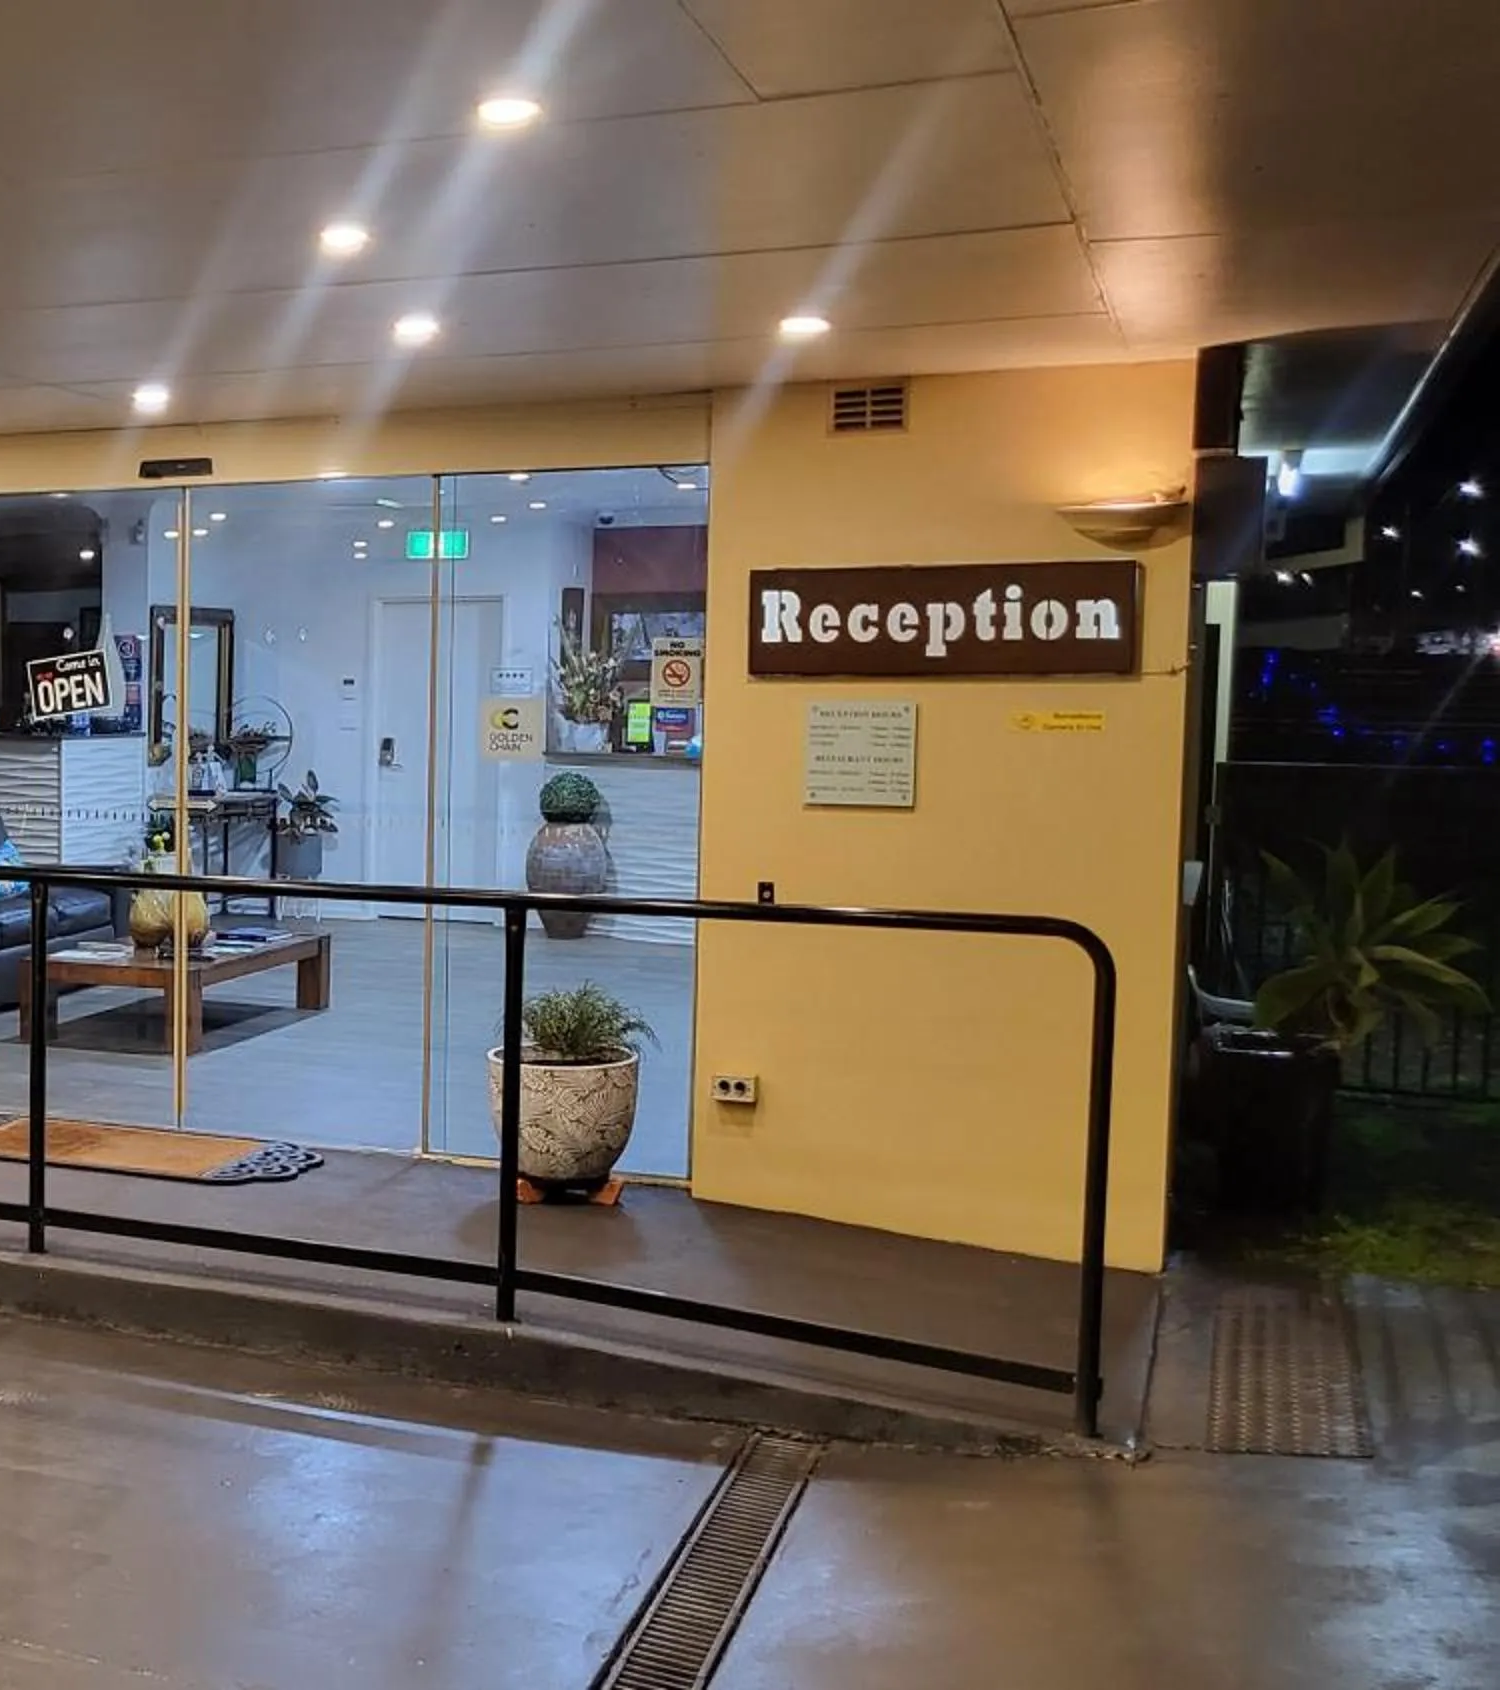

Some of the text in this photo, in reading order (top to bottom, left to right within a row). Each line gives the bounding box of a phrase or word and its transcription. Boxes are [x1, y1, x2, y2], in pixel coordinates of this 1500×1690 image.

[761, 584, 1121, 657] Reception
[654, 649, 703, 657] SMOKING
[670, 641, 686, 649] NO
[37, 671, 106, 714] OPEN
